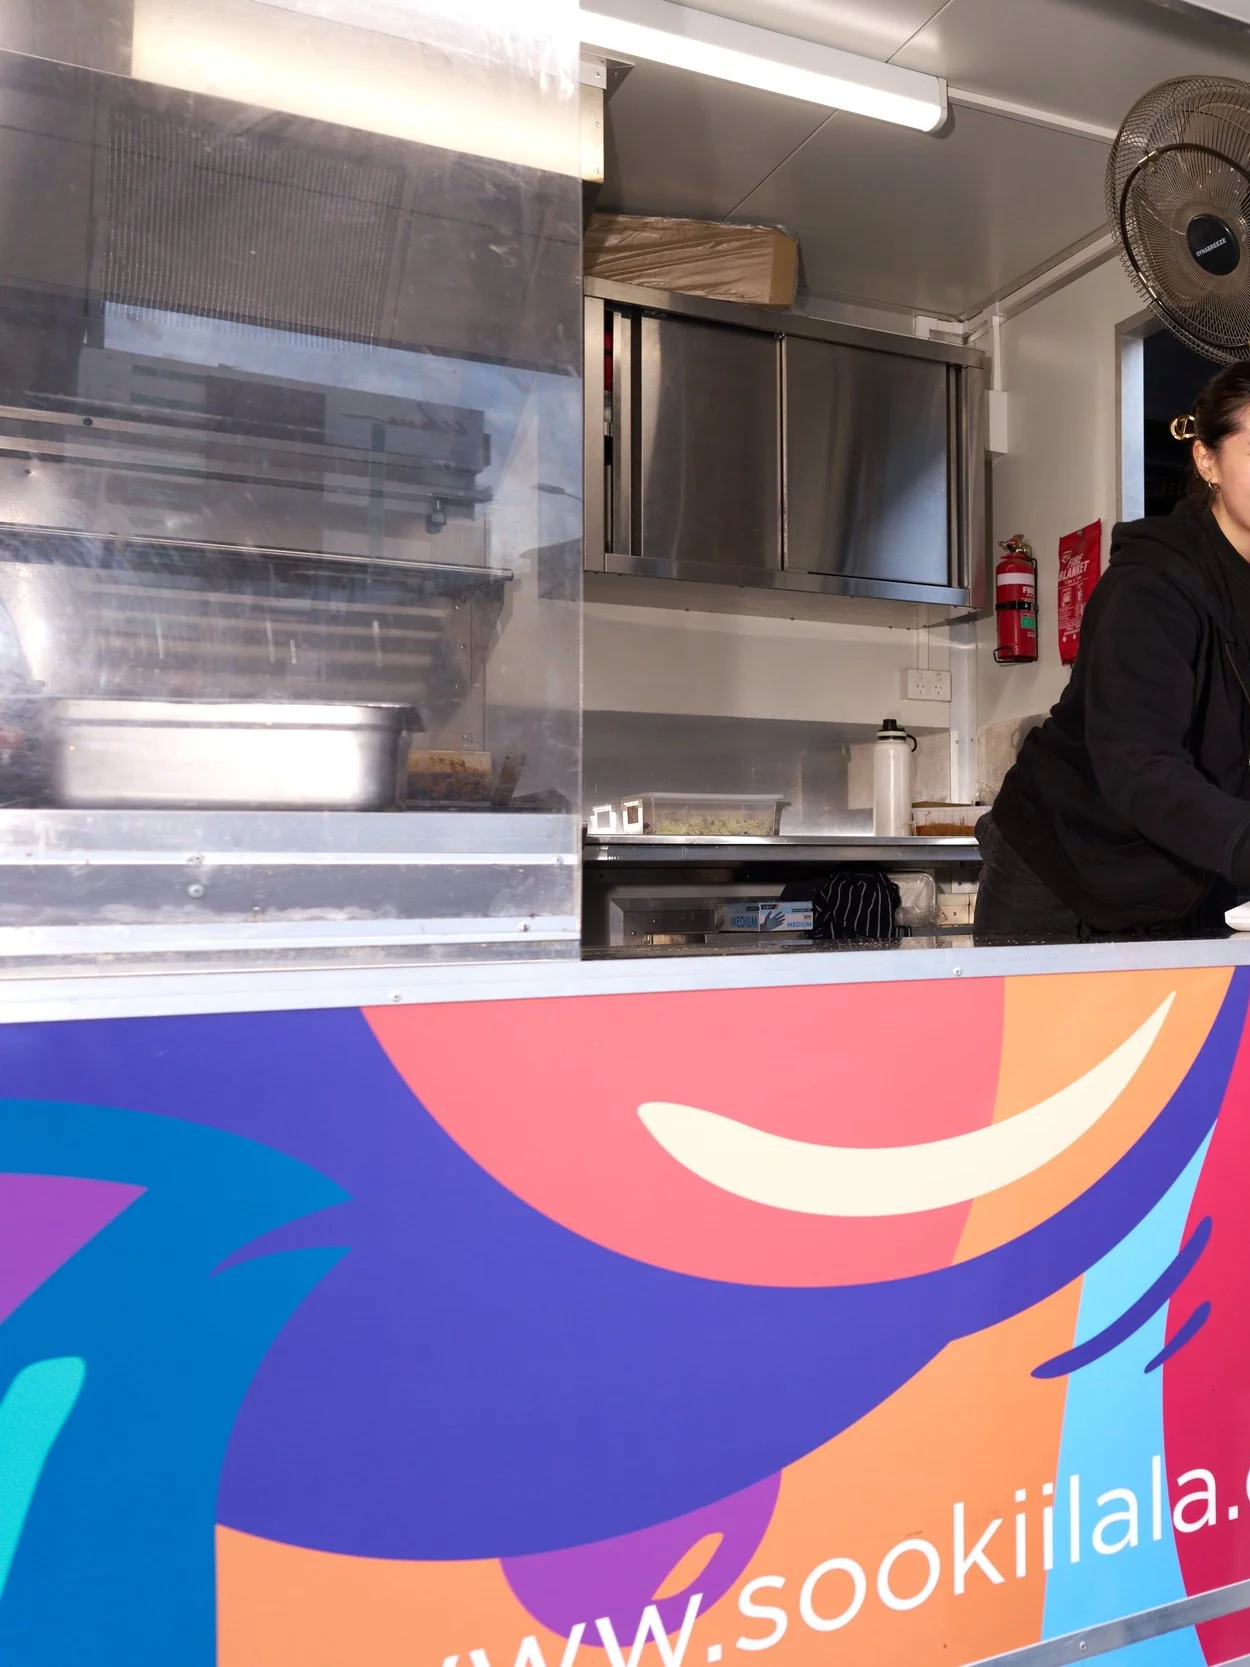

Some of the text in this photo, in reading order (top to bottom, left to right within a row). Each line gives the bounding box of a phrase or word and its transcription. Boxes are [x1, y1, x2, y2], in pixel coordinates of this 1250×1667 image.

[1195, 237, 1227, 257] DYNABREEZE
[1067, 553, 1084, 569] FIRE
[1059, 560, 1090, 581] BLANKET
[730, 916, 758, 928] MEDIUM
[787, 920, 812, 928] MEDIUM
